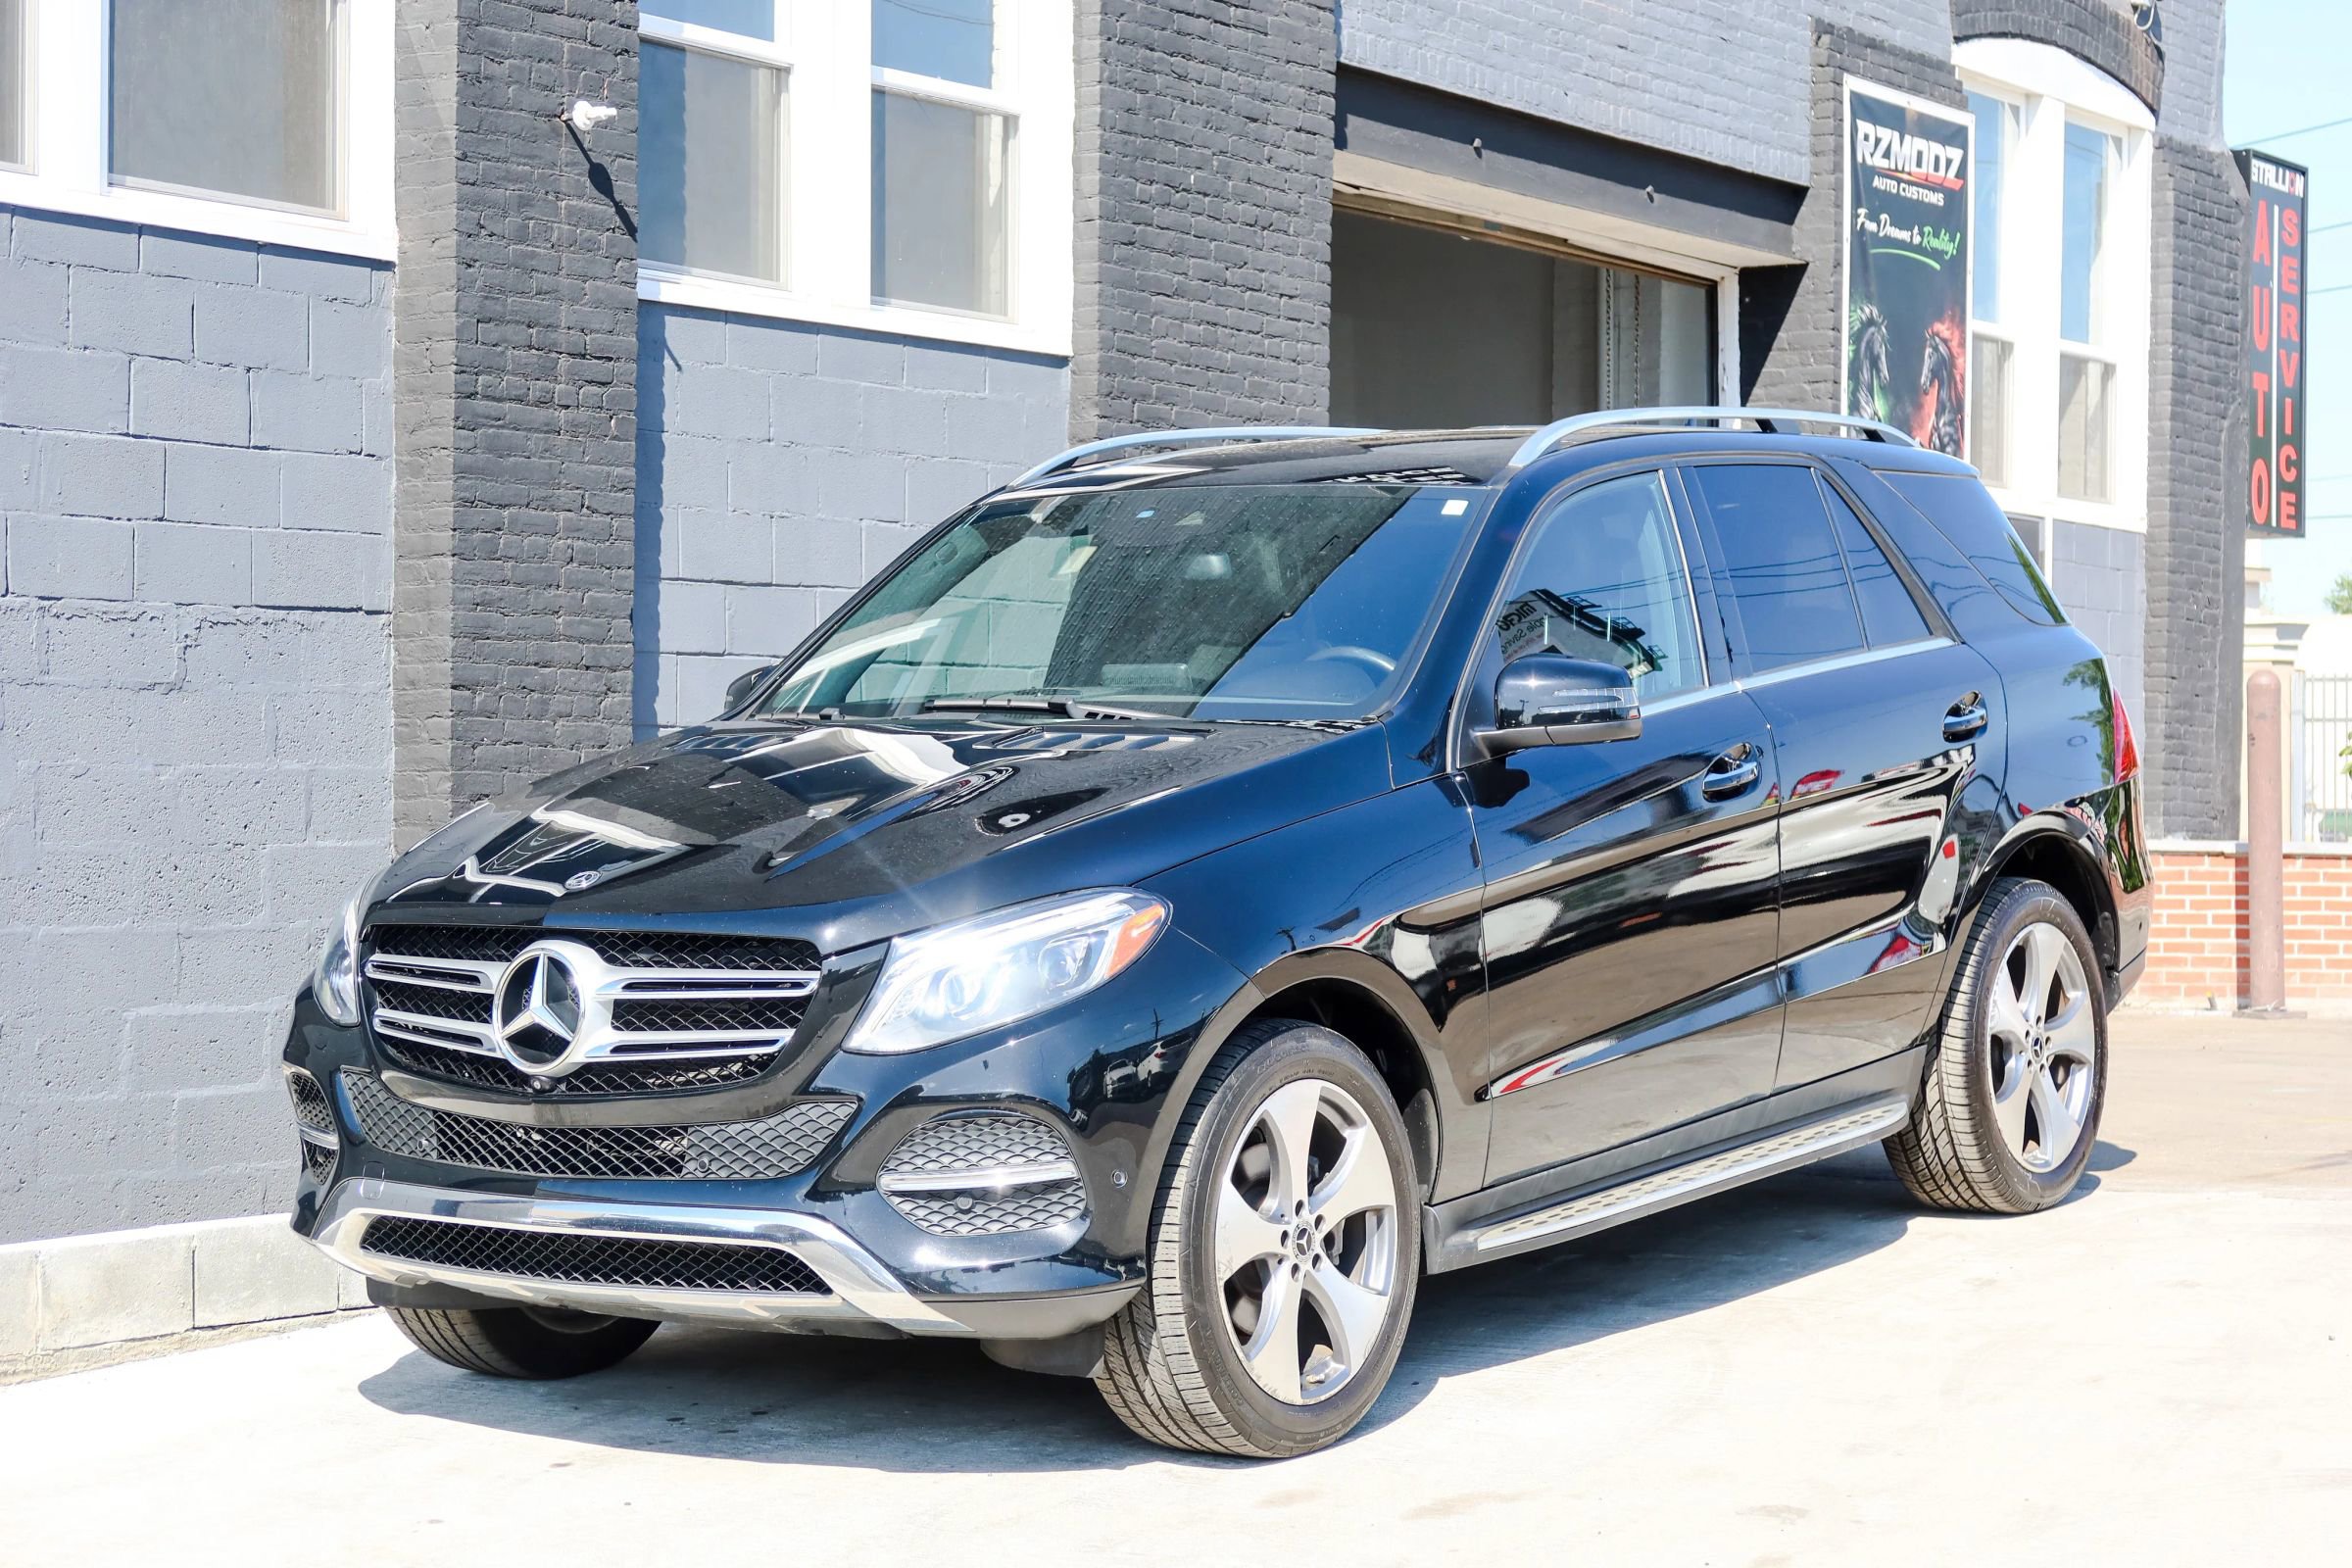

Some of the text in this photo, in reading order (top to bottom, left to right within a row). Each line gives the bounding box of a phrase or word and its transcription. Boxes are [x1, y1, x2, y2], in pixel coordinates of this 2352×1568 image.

[1856, 119, 1964, 191] RZMODZ
[2251, 159, 2304, 198] STALLION
[1872, 174, 1944, 206] AUTO CUSTOMS
[1857, 208, 1961, 260] From Dreams to Reality!
[2251, 199, 2271, 525] AUTO
[2279, 208, 2300, 530] SERVICE
